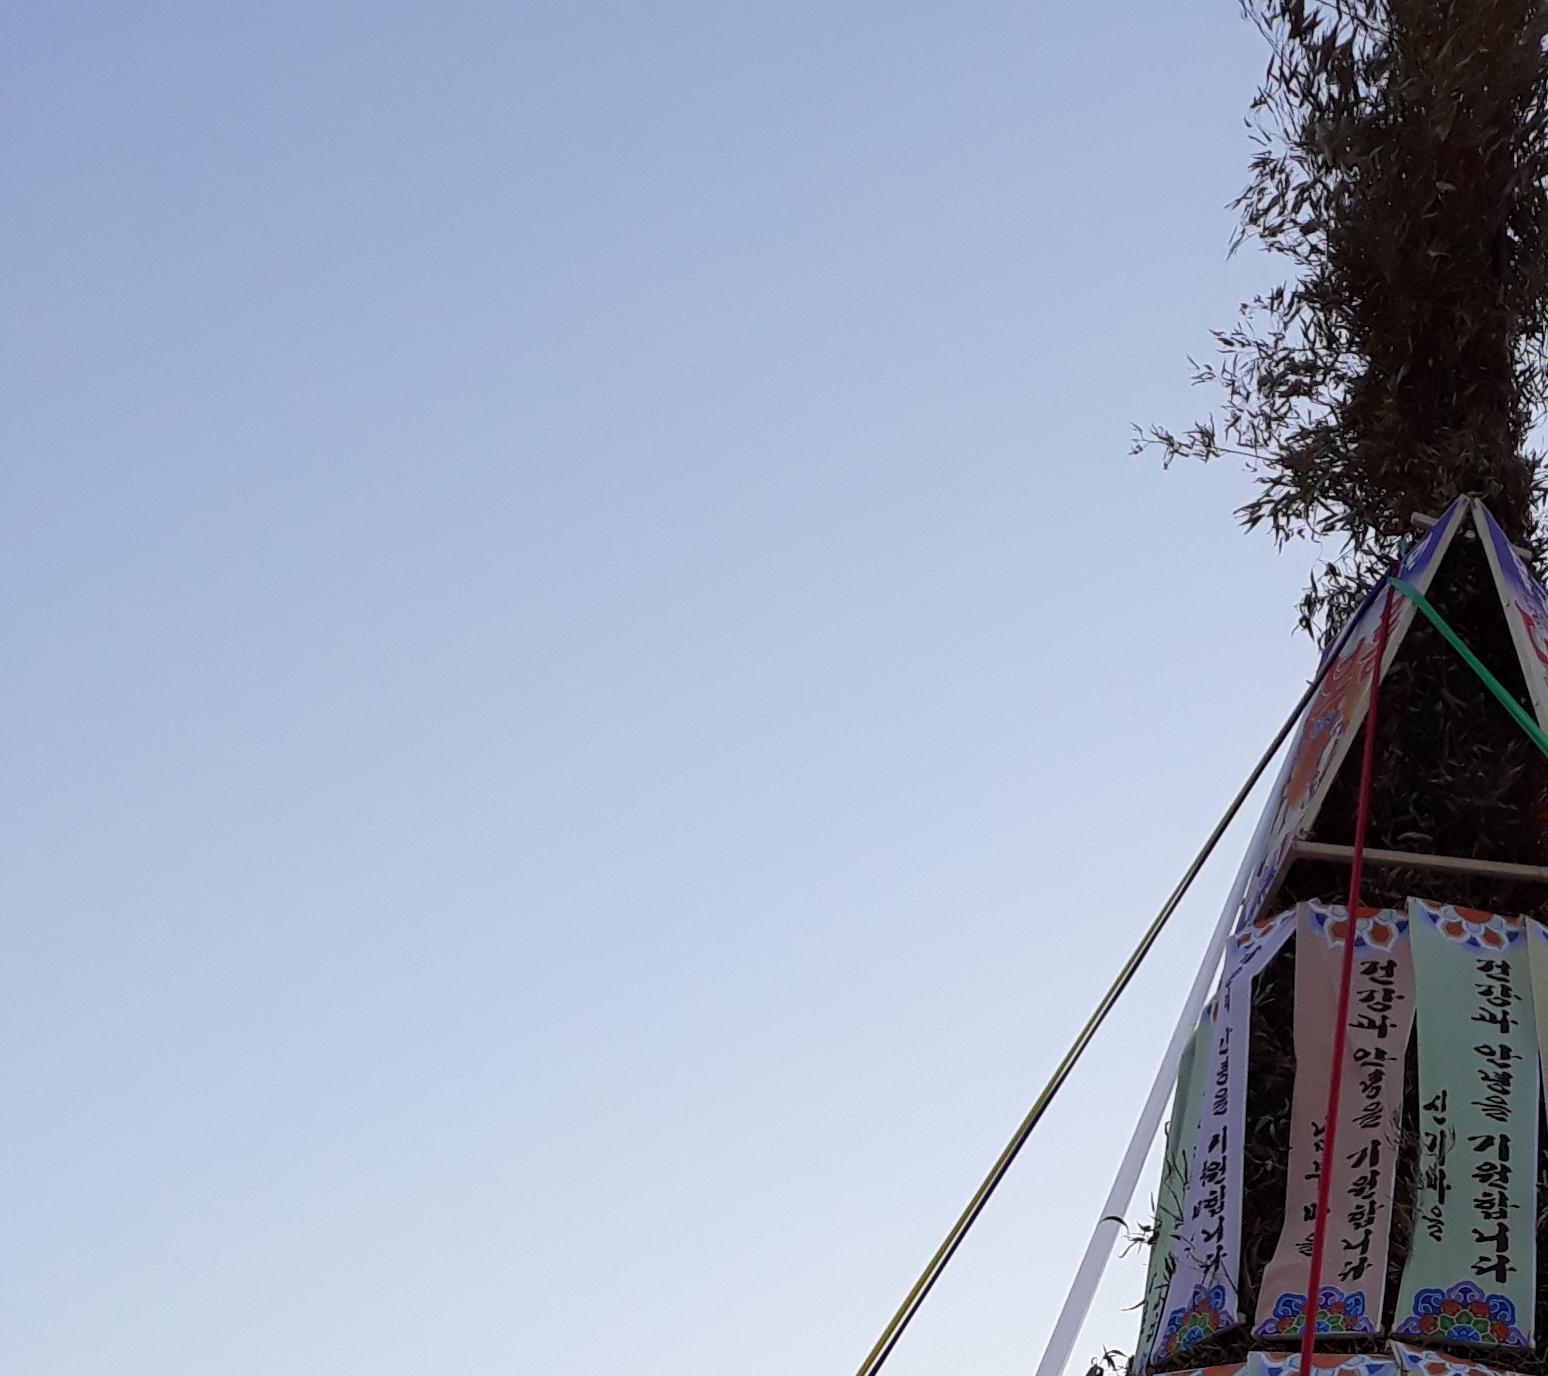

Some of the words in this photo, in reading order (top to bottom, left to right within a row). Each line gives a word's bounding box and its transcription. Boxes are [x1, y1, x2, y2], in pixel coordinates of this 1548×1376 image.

[1349, 959, 1405, 1039] 건강과
[1471, 958, 1523, 1035] 건강과
[1352, 1047, 1398, 1129] 안녕을
[1471, 1044, 1524, 1123] 안녕을
[1199, 1124, 1228, 1274] 기원합니다
[1337, 1138, 1385, 1282] 기원합니다
[1422, 1089, 1452, 1242] 신기마을
[1467, 1134, 1521, 1285] 기원합니다
